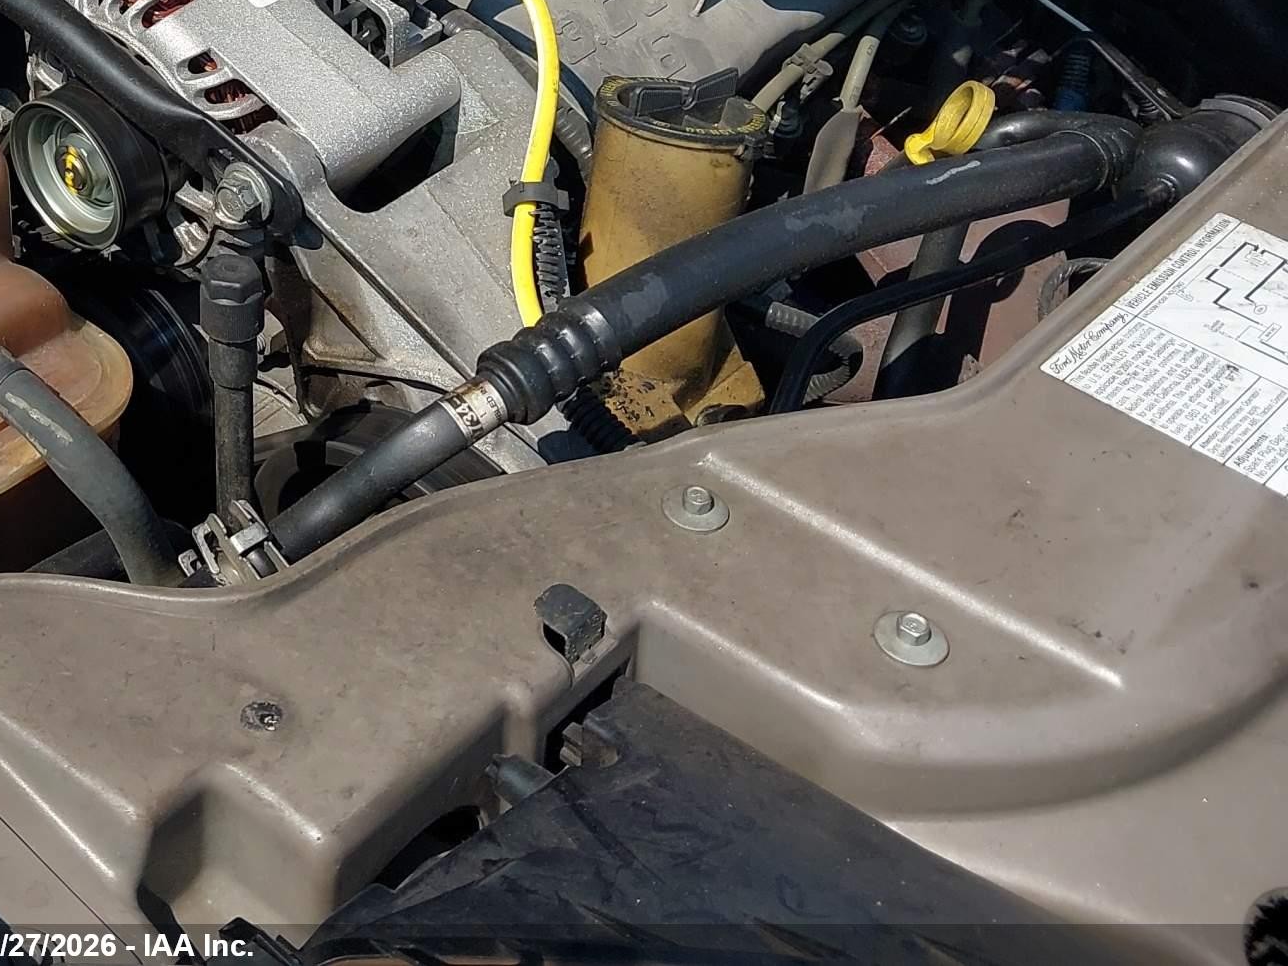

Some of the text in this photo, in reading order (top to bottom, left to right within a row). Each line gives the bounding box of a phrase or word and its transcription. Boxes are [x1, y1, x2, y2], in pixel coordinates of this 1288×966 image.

[1125, 219, 1231, 308] VEHICLE EMISSION CONTROL INFORMATION
[1049, 355, 1072, 374] Ford
[1065, 340, 1091, 363] Motor
[1234, 434, 1268, 466] Adjustments:
[1243, 457, 1263, 472] Spark
[1257, 445, 1276, 457] Plug
